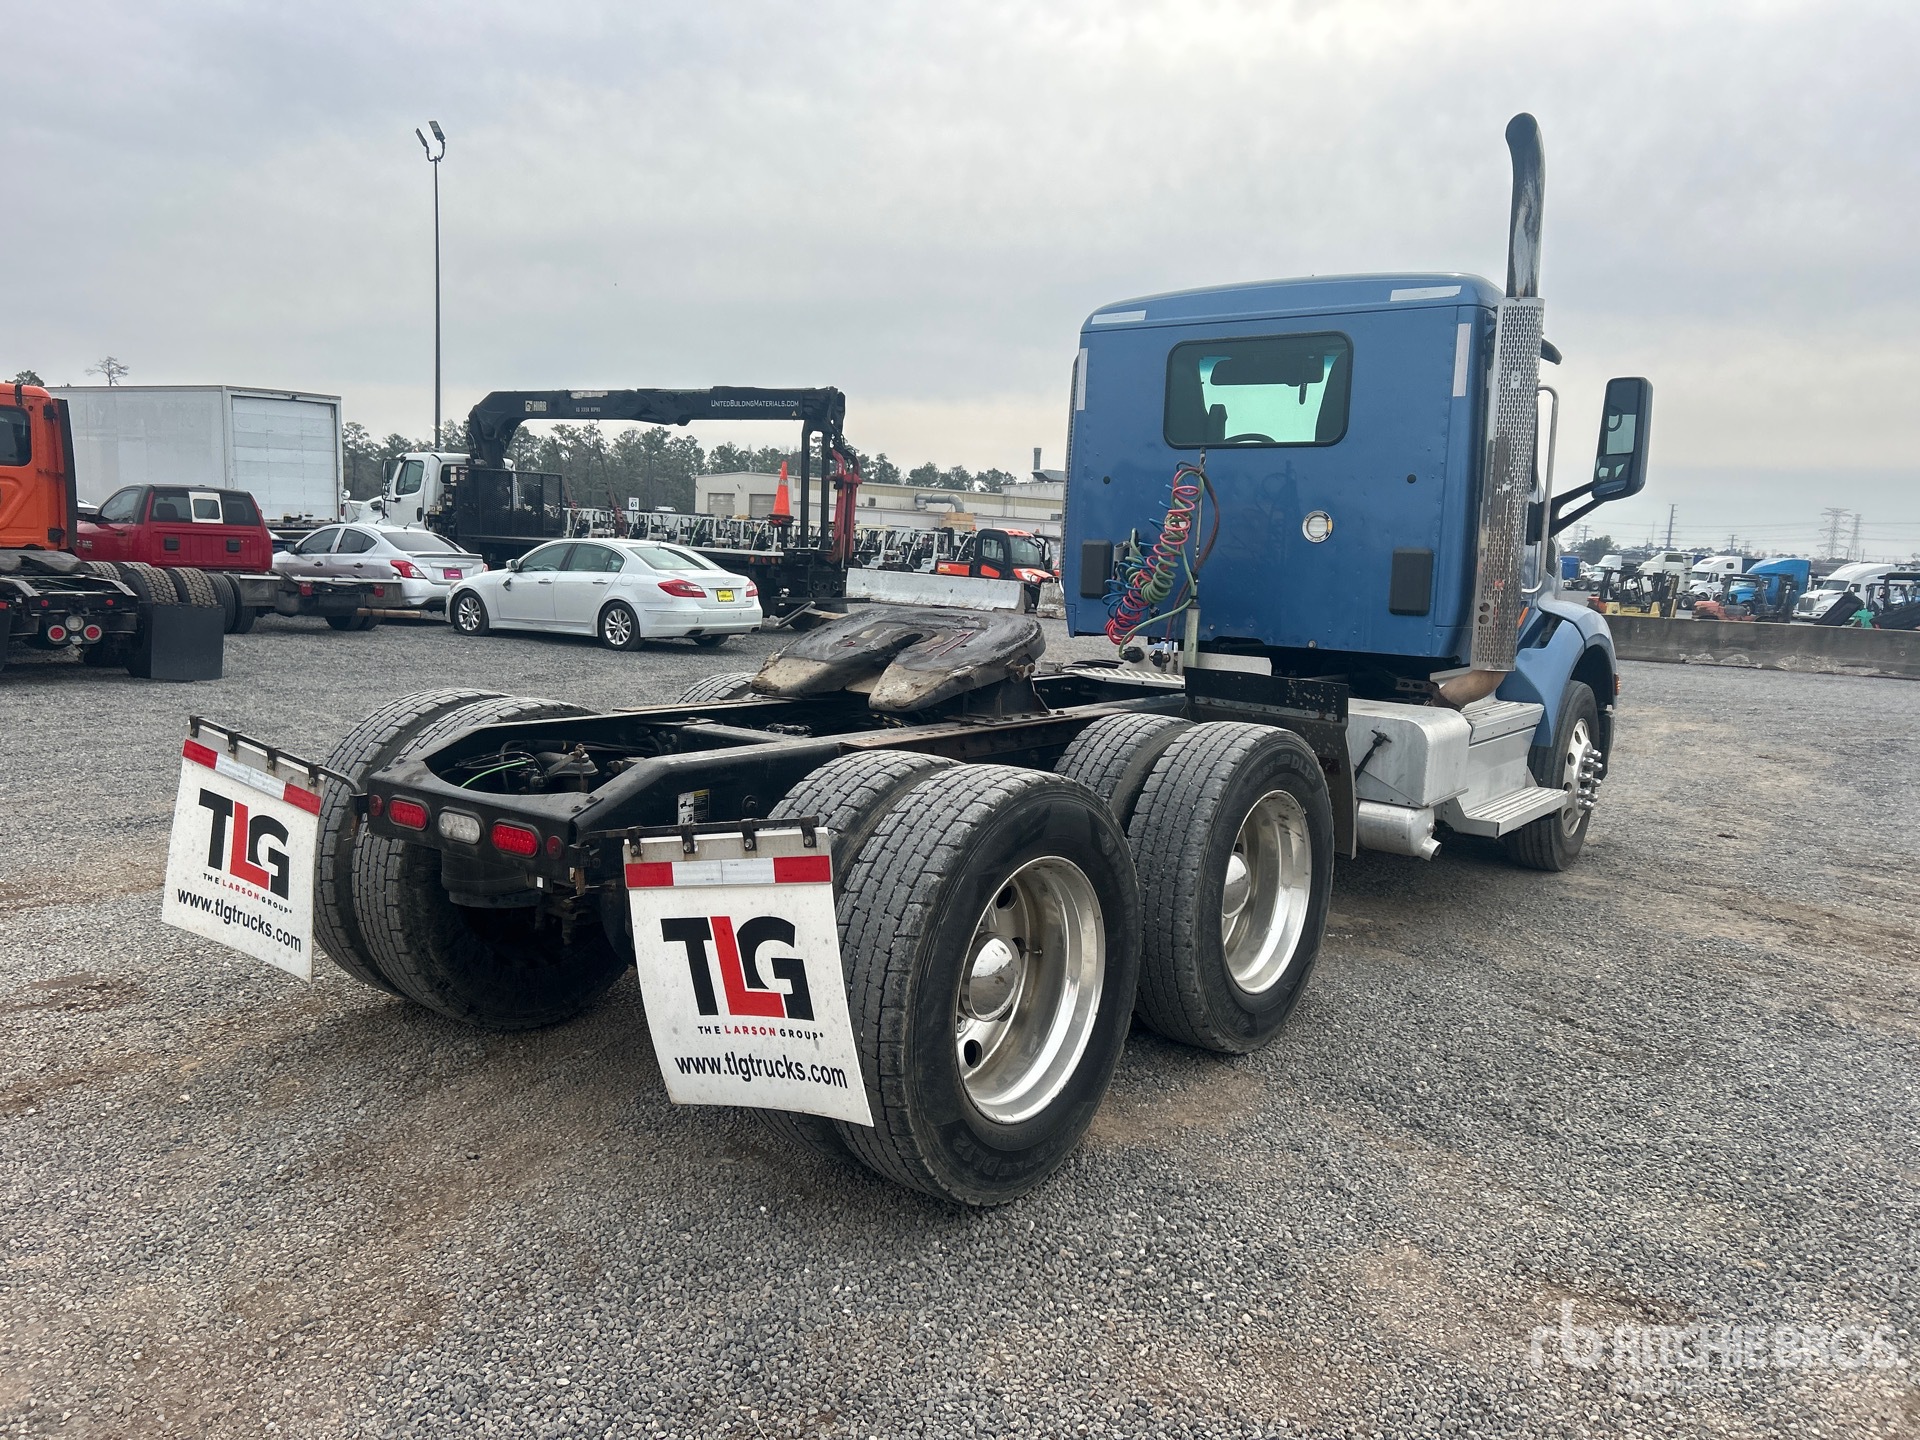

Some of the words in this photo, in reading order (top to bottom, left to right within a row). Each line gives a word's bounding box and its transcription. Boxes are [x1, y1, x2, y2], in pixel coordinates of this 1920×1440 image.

[533, 401, 547, 412] HIAB
[198, 788, 290, 900] TLG
[203, 872, 220, 884] THE
[222, 879, 260, 901] LARSON
[177, 888, 302, 953] www.tlgtrucks.com
[660, 916, 815, 1021] TLG
[698, 1026, 721, 1035] THE
[724, 1025, 776, 1037] LARSON
[675, 1051, 848, 1089] www.tlgtrucks.com
